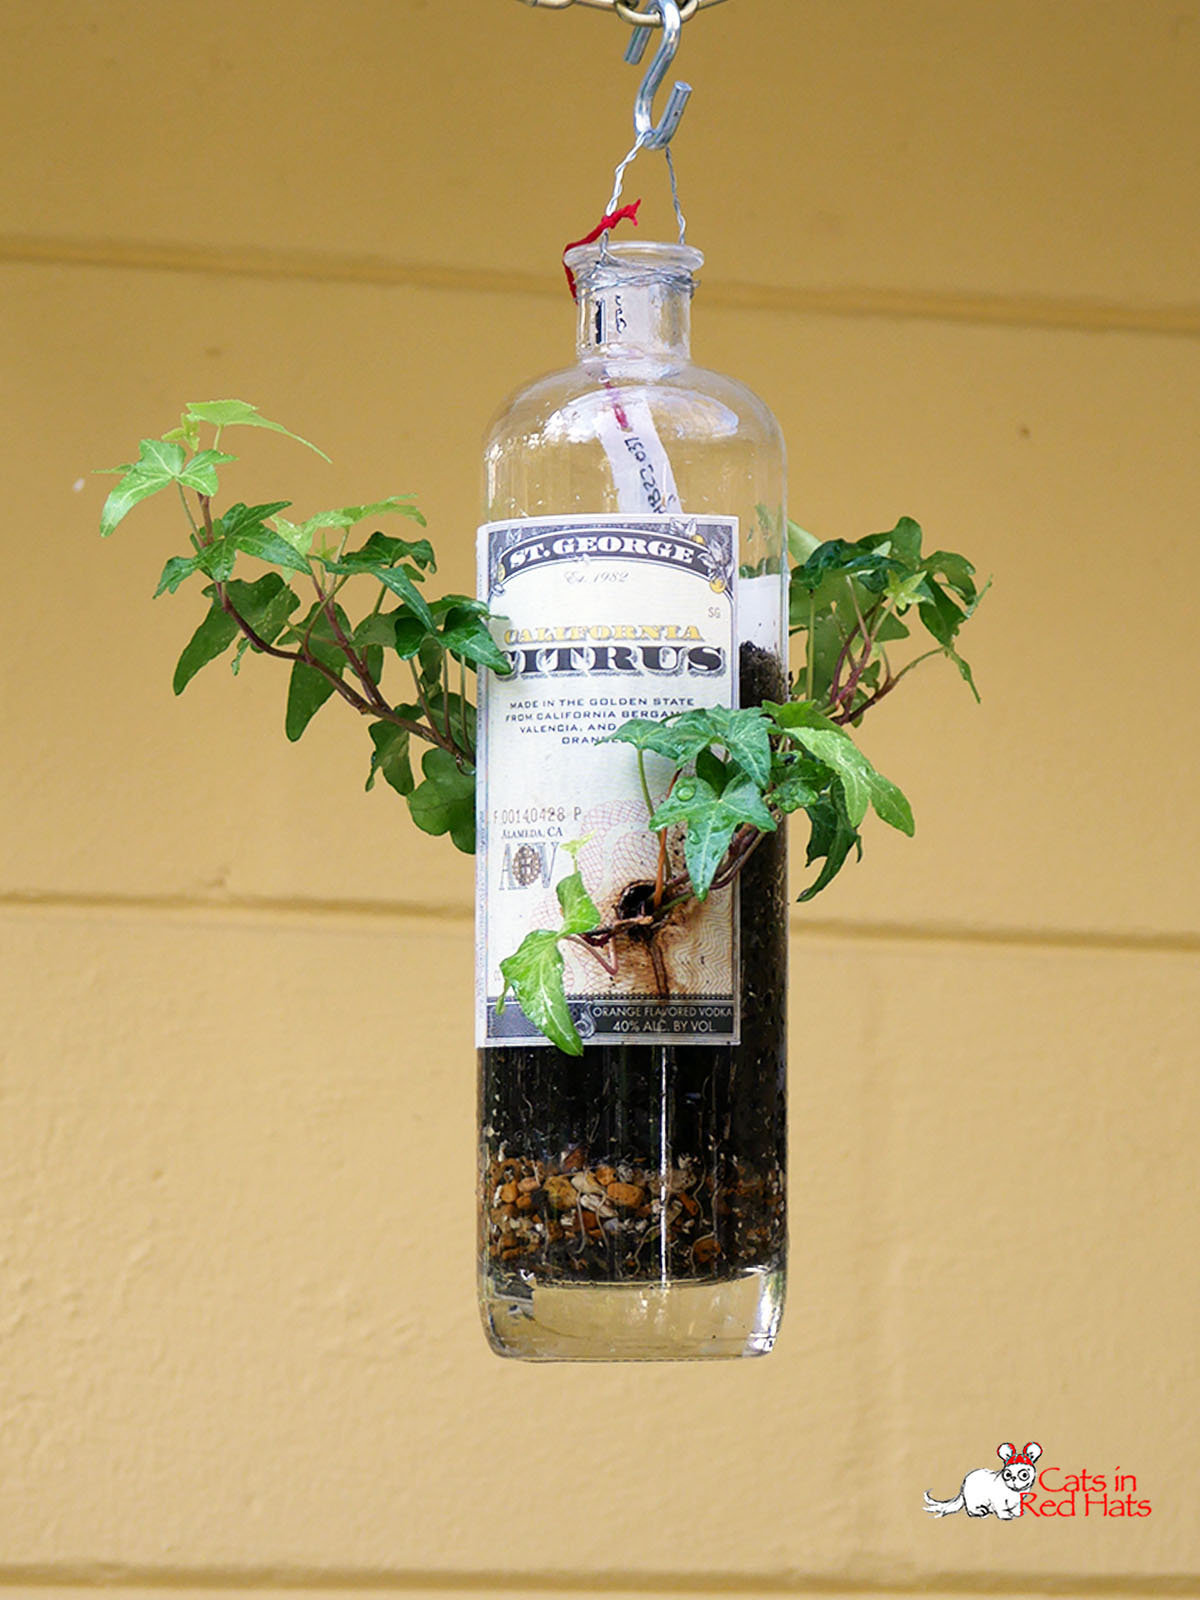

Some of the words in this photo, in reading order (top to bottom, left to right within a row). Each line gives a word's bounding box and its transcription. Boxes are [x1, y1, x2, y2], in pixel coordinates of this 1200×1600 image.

[509, 545, 551, 568] ST.
[552, 536, 695, 563] GEORGE
[592, 571, 630, 584] 1982
[504, 625, 704, 645] CALIFORNIA
[498, 645, 727, 680] ITRUS
[510, 701, 538, 709] MADE
[543, 700, 555, 708] IN
[559, 698, 584, 707] THE
[589, 698, 647, 706] GOLDEN
[653, 698, 695, 706] STATE
[505, 713, 532, 722] FROM
[536, 710, 616, 721] CALIFORNIA
[622, 710, 682, 719] BERGA
[587, 723, 617, 732] AND
[573, 806, 582, 821] P
[547, 826, 563, 837] CA
[592, 1006, 641, 1018] ORANGE
[644, 1006, 697, 1017] FLAVORED
[699, 1007, 733, 1017] VODKA
[612, 1020, 640, 1033] 40%
[673, 1020, 689, 1032] BY
